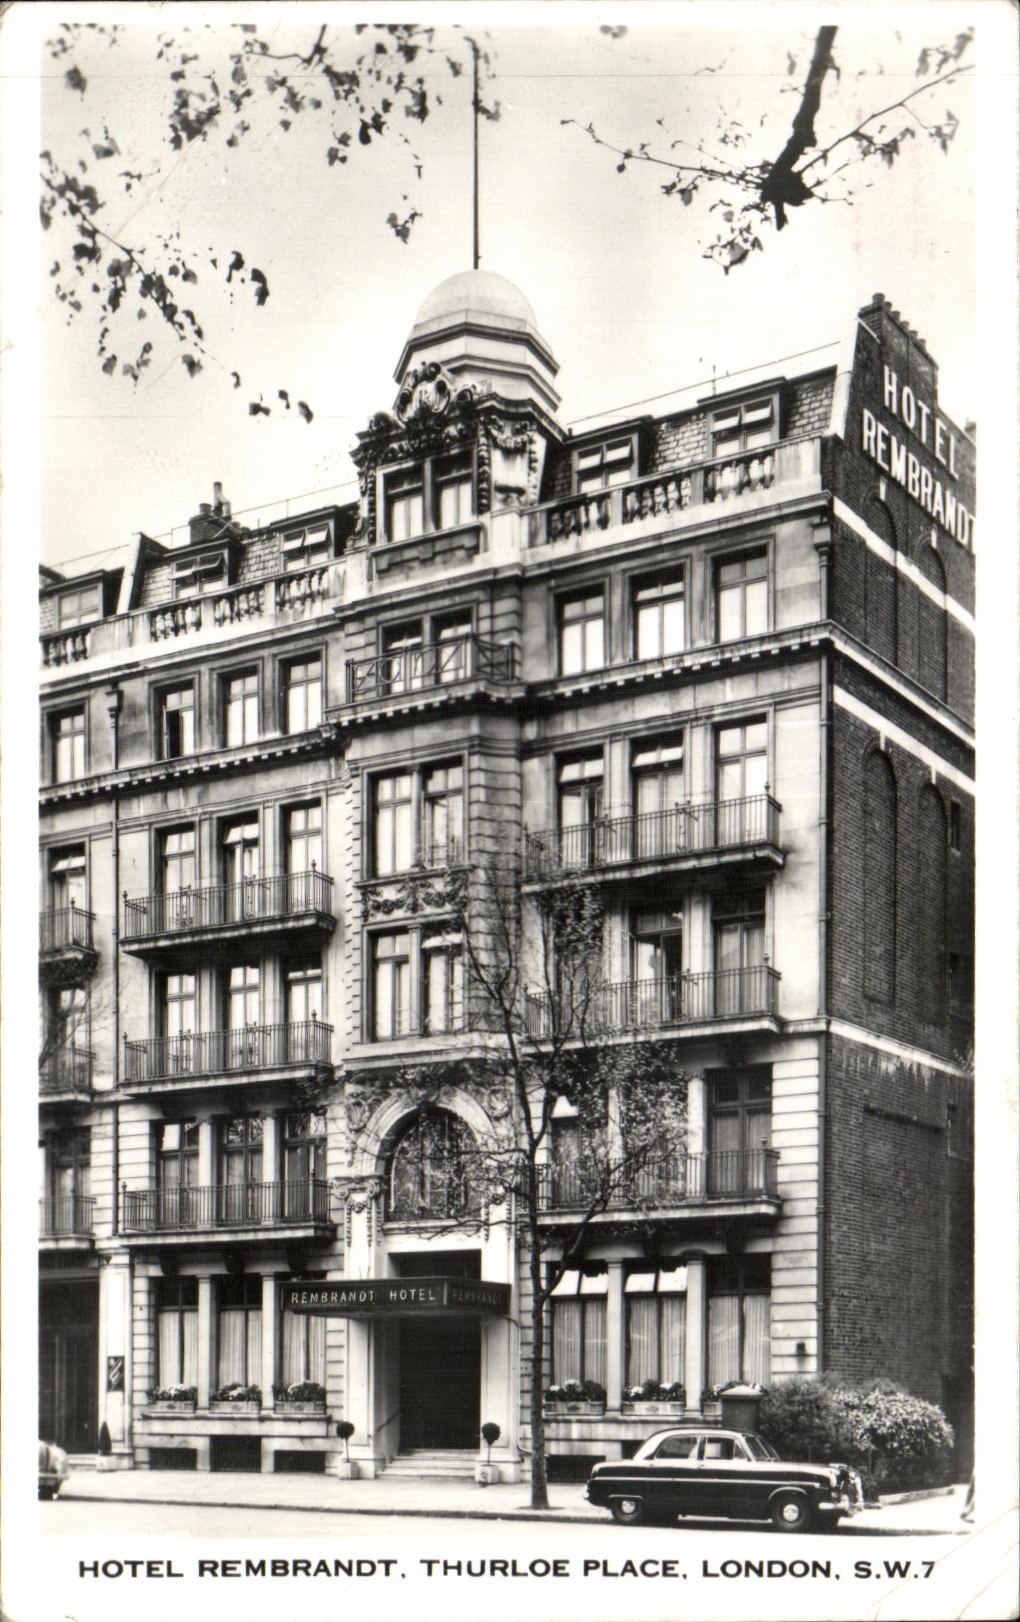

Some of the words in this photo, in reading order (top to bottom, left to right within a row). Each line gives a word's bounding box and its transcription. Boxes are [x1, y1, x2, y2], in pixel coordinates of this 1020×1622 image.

[883, 364, 959, 480] HOTEL
[291, 1290, 375, 1304] REMBRANDT
[389, 1288, 436, 1301] HOTEL
